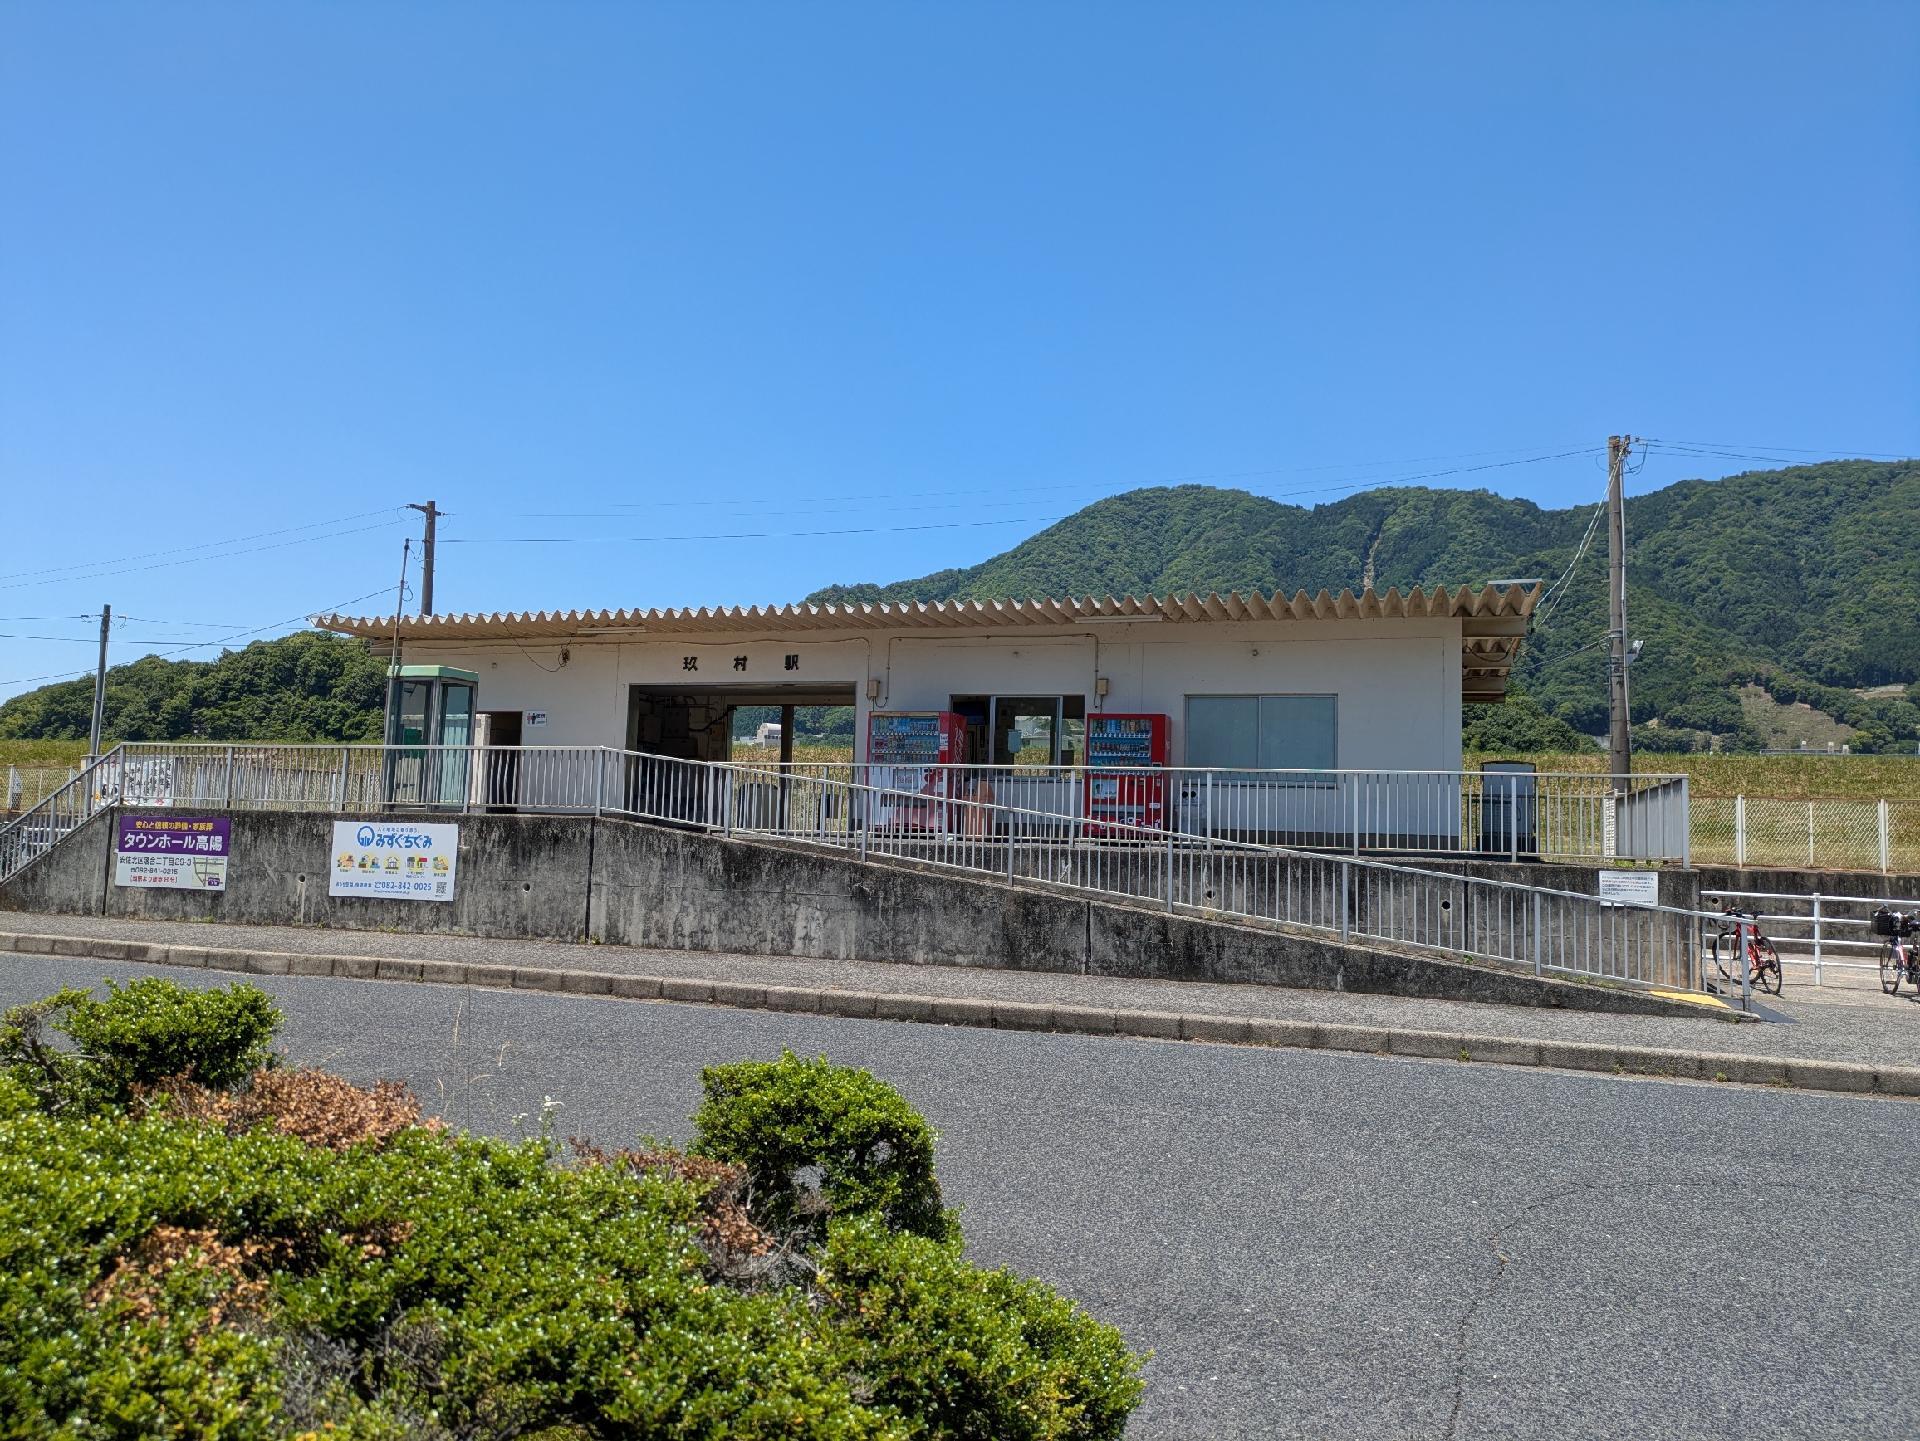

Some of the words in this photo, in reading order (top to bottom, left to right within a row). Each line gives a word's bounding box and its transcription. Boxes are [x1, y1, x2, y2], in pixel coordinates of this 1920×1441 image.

[683, 654, 799, 671] 玖村駅
[124, 833, 223, 851] タウンホール高陽
[375, 833, 433, 848] みずぐちぐみ
